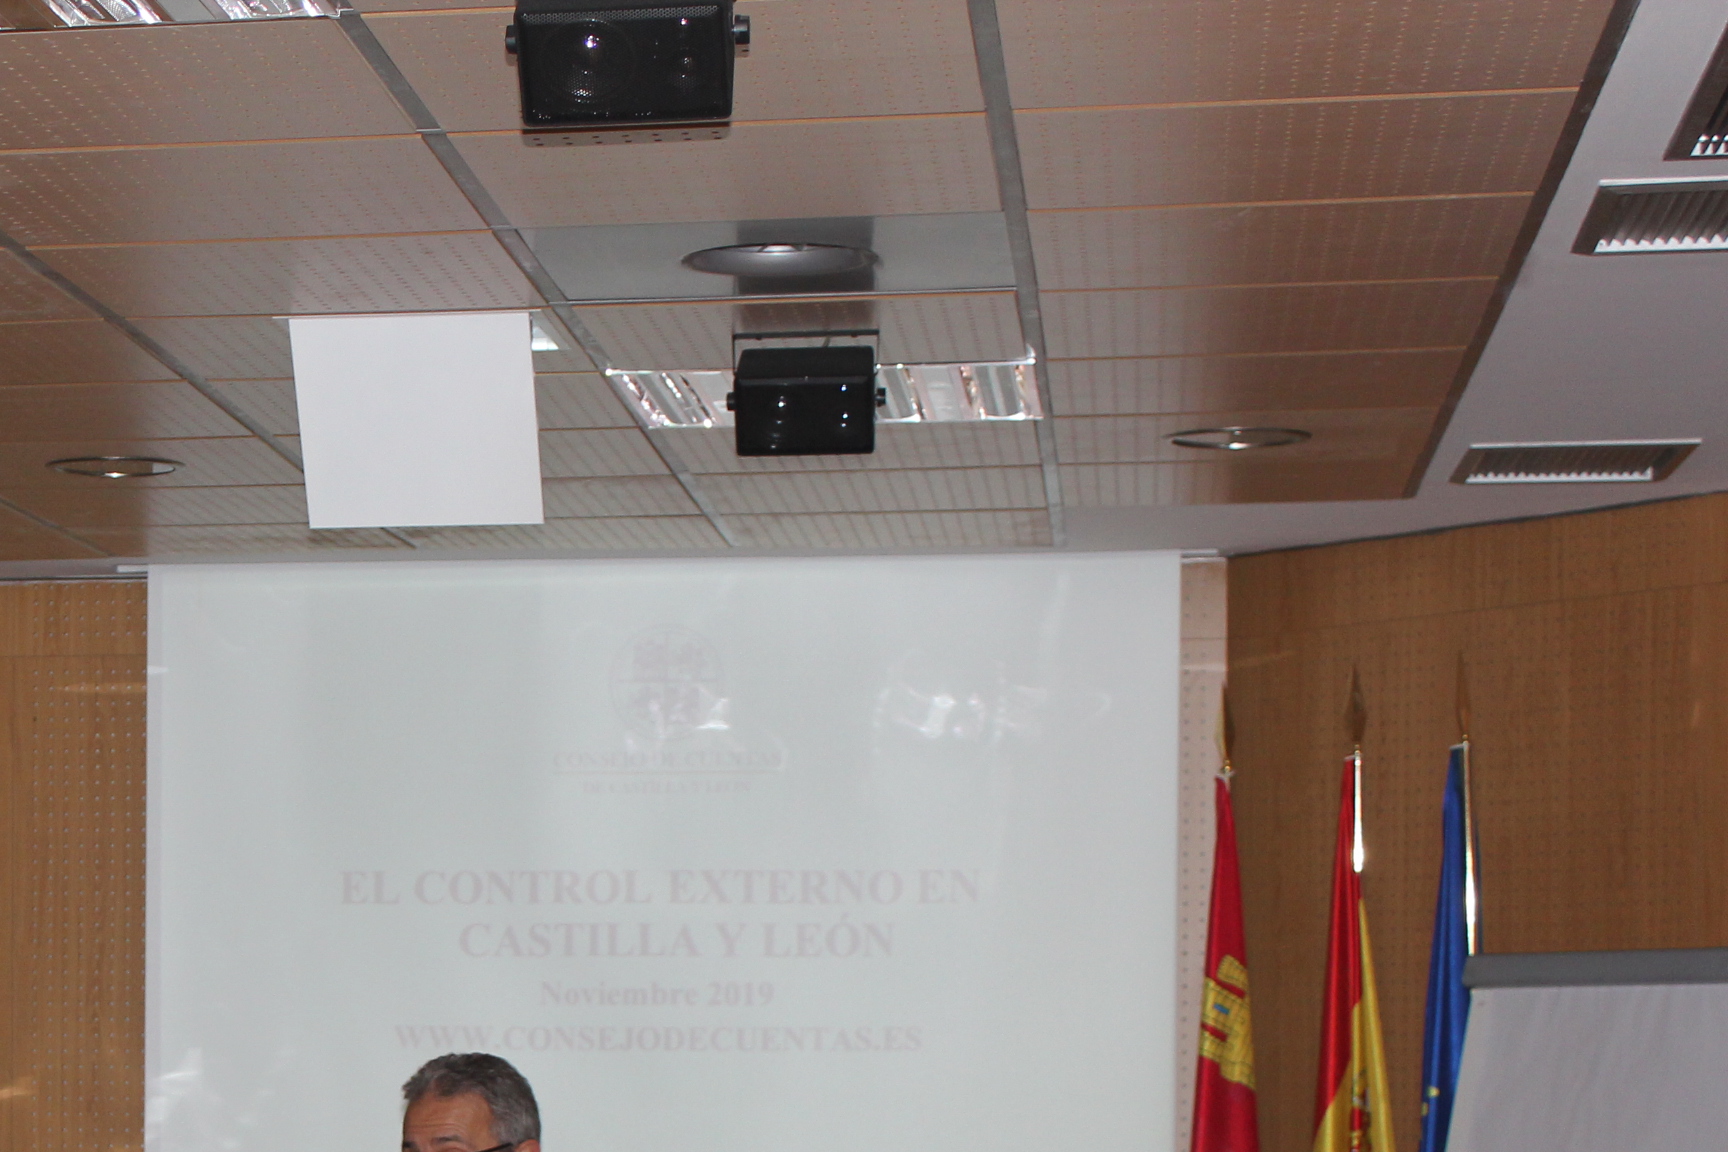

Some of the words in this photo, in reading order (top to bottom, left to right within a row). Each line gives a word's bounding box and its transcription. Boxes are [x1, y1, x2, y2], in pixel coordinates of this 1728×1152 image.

[339, 869, 401, 905] EL
[411, 868, 654, 906] CONTROL
[668, 868, 905, 906] EXTERNO
[911, 869, 982, 905] EN
[458, 921, 702, 959] CASTILLA
[714, 922, 747, 958] Y
[762, 912, 896, 959] LEÓN
[538, 980, 700, 1009] Noviembre
[706, 980, 775, 1009] 2019
[393, 1024, 924, 1055] WWW.CONSEJODECUENTAS.ES
